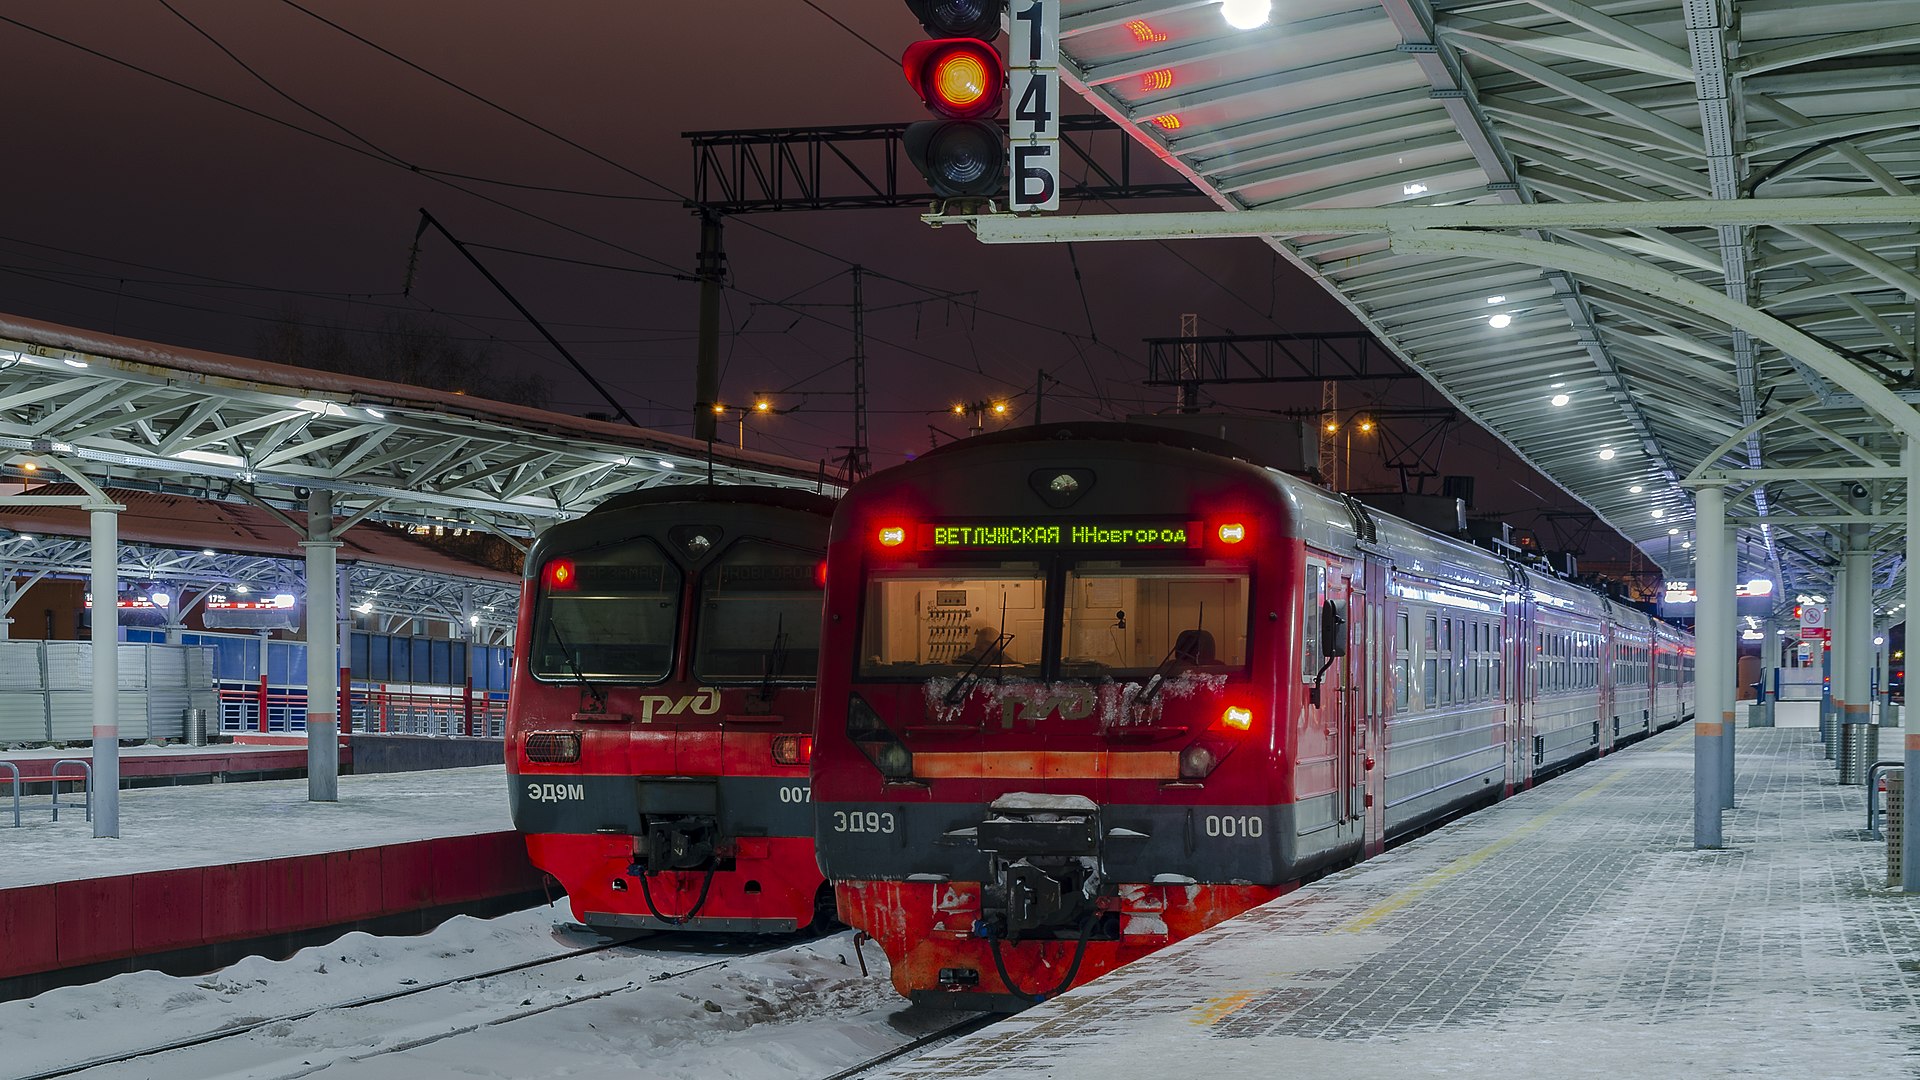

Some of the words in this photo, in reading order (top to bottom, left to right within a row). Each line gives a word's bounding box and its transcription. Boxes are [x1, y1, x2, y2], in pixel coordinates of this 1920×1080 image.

[935, 527, 1060, 545] ВЕТЛУЖСКАЯ
[1072, 526, 1187, 544] ННовгород
[208, 594, 218, 603] 17
[527, 783, 585, 803] ЭД9М
[1205, 815, 1263, 838] 0010
